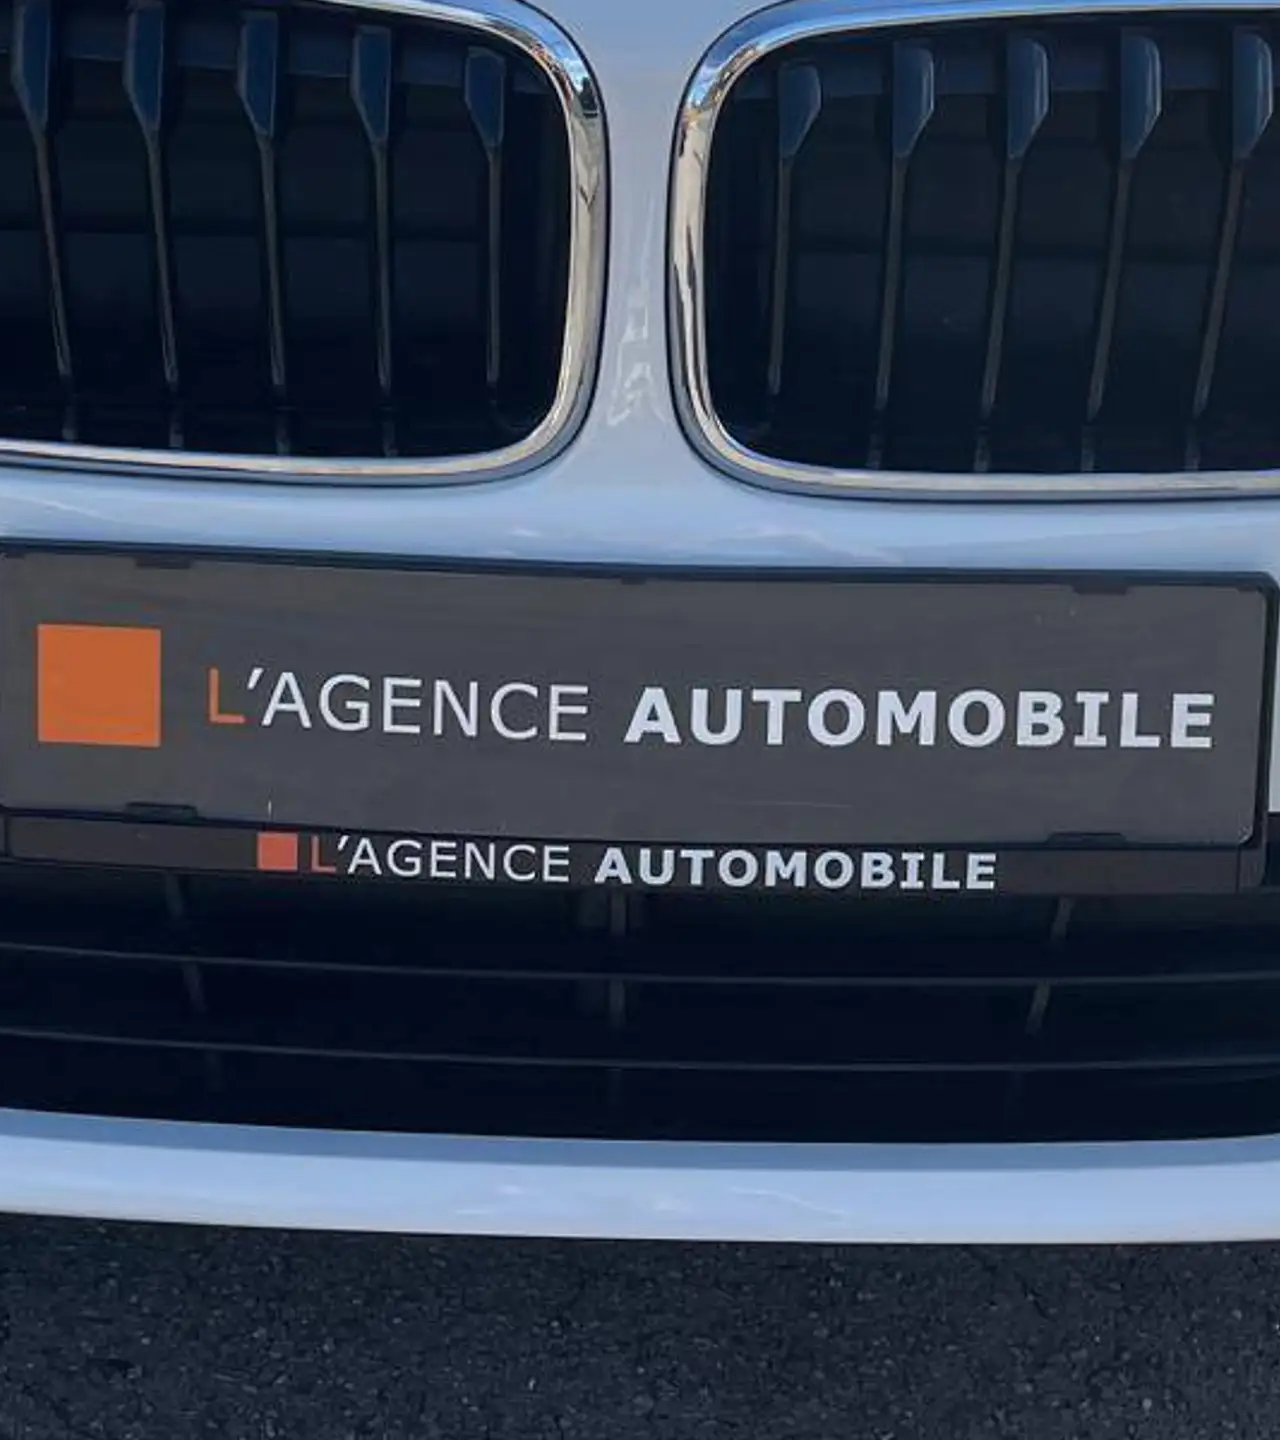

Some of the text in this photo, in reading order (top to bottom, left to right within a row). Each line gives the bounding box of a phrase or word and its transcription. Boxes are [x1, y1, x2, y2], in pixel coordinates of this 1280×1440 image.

[206, 667, 1216, 748] L'AGENCE AUTOMOBILE
[310, 834, 998, 890] L'AGENCE AUTOMOBILE
